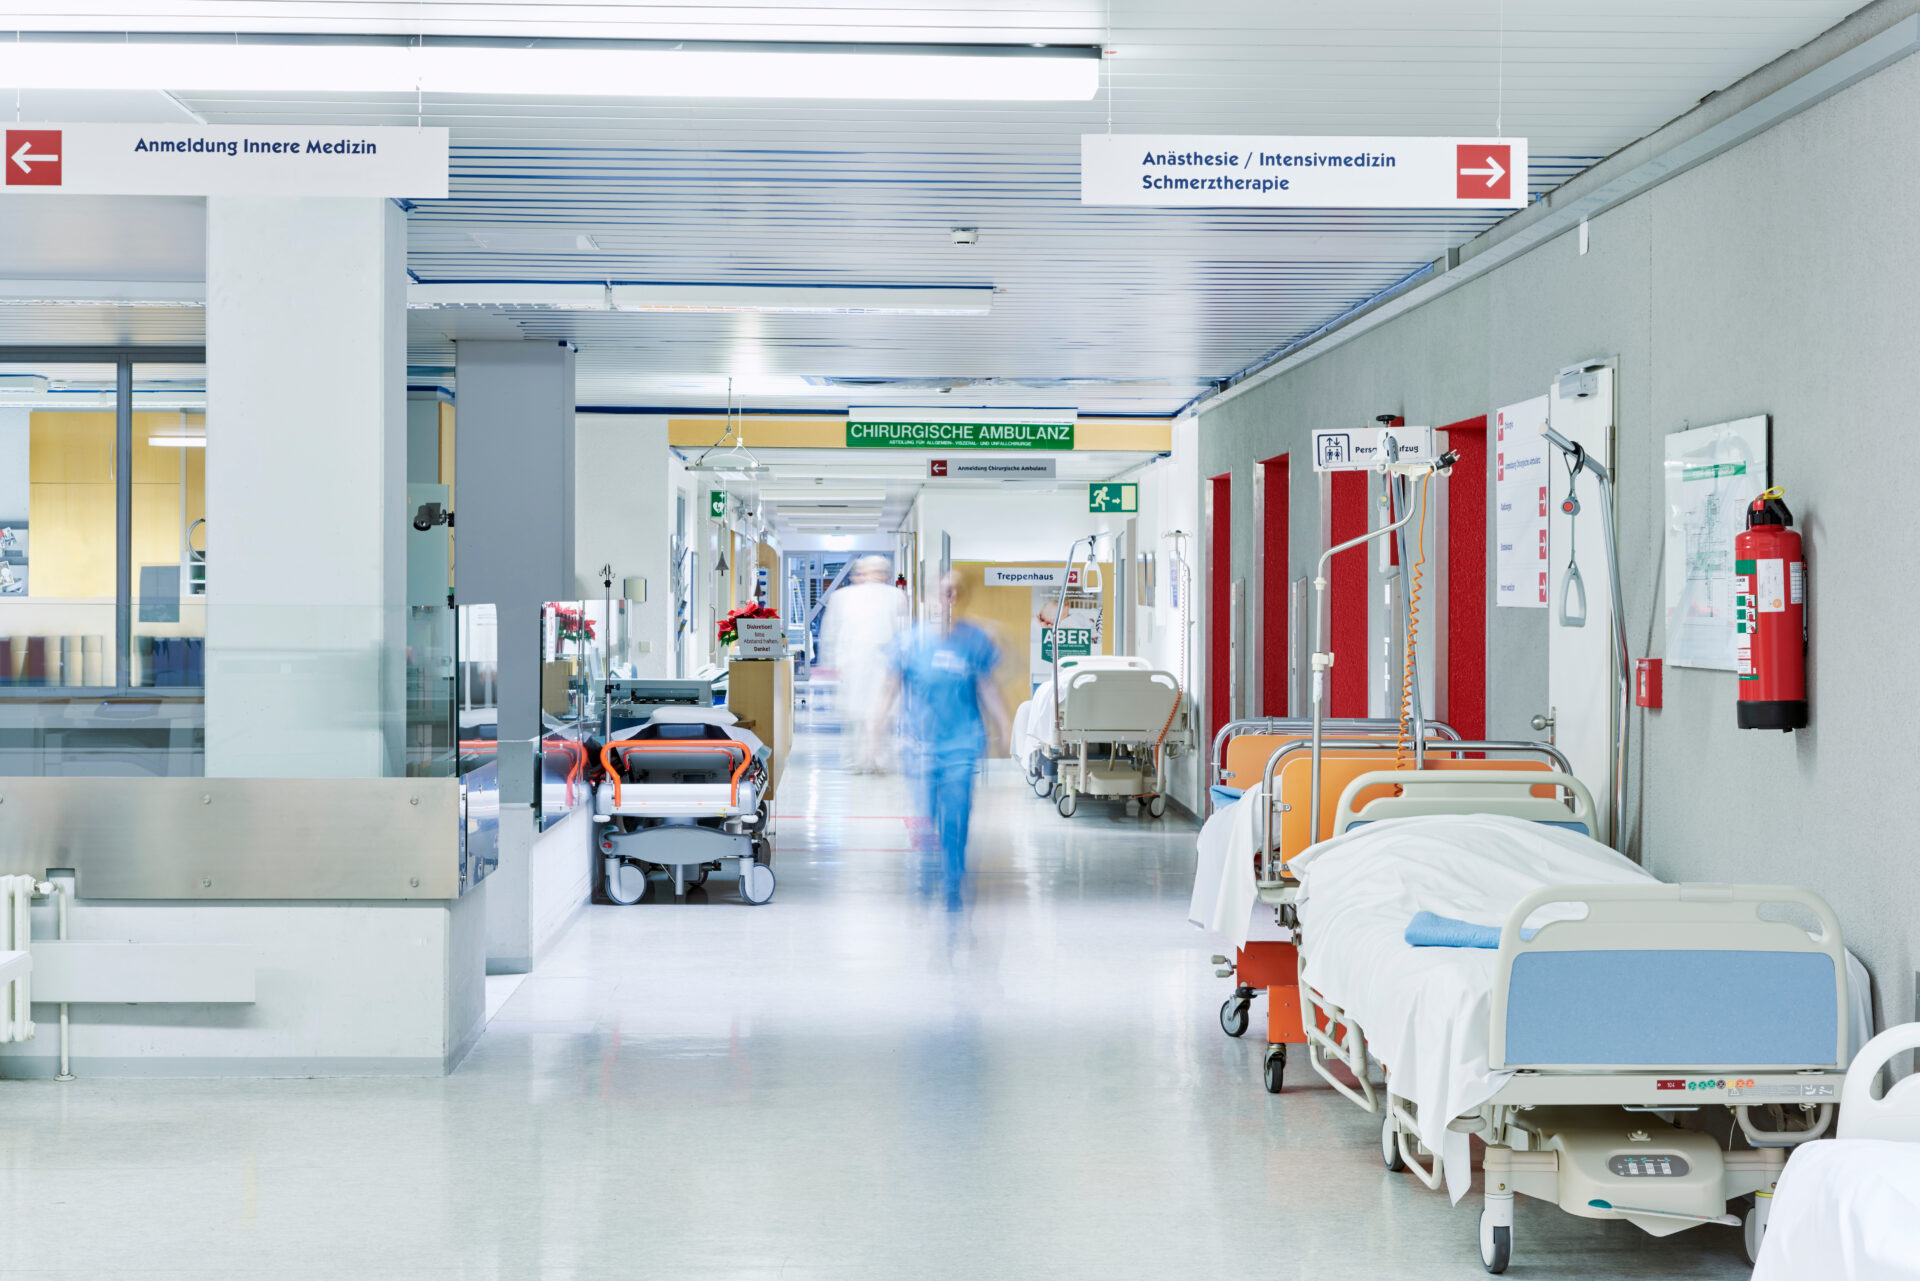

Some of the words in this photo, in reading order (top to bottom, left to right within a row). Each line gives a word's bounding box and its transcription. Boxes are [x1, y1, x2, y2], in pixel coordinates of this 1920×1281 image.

[134, 138, 238, 156] Anmeldung
[243, 138, 301, 154] Innere
[306, 138, 377, 155] Medizin
[1142, 150, 1239, 167] Anästhesie
[1244, 151, 1253, 169] /
[1259, 151, 1396, 168] Intensivmedizin
[1142, 174, 1290, 194] Schmerztherapie
[850, 424, 974, 439] CHIRURGISCHE
[978, 426, 1070, 440] AMBULANZ
[1355, 445, 1419, 453] Persfzug
[997, 572, 1054, 582] Treppenhaus
[1043, 630, 1089, 645] ABER
